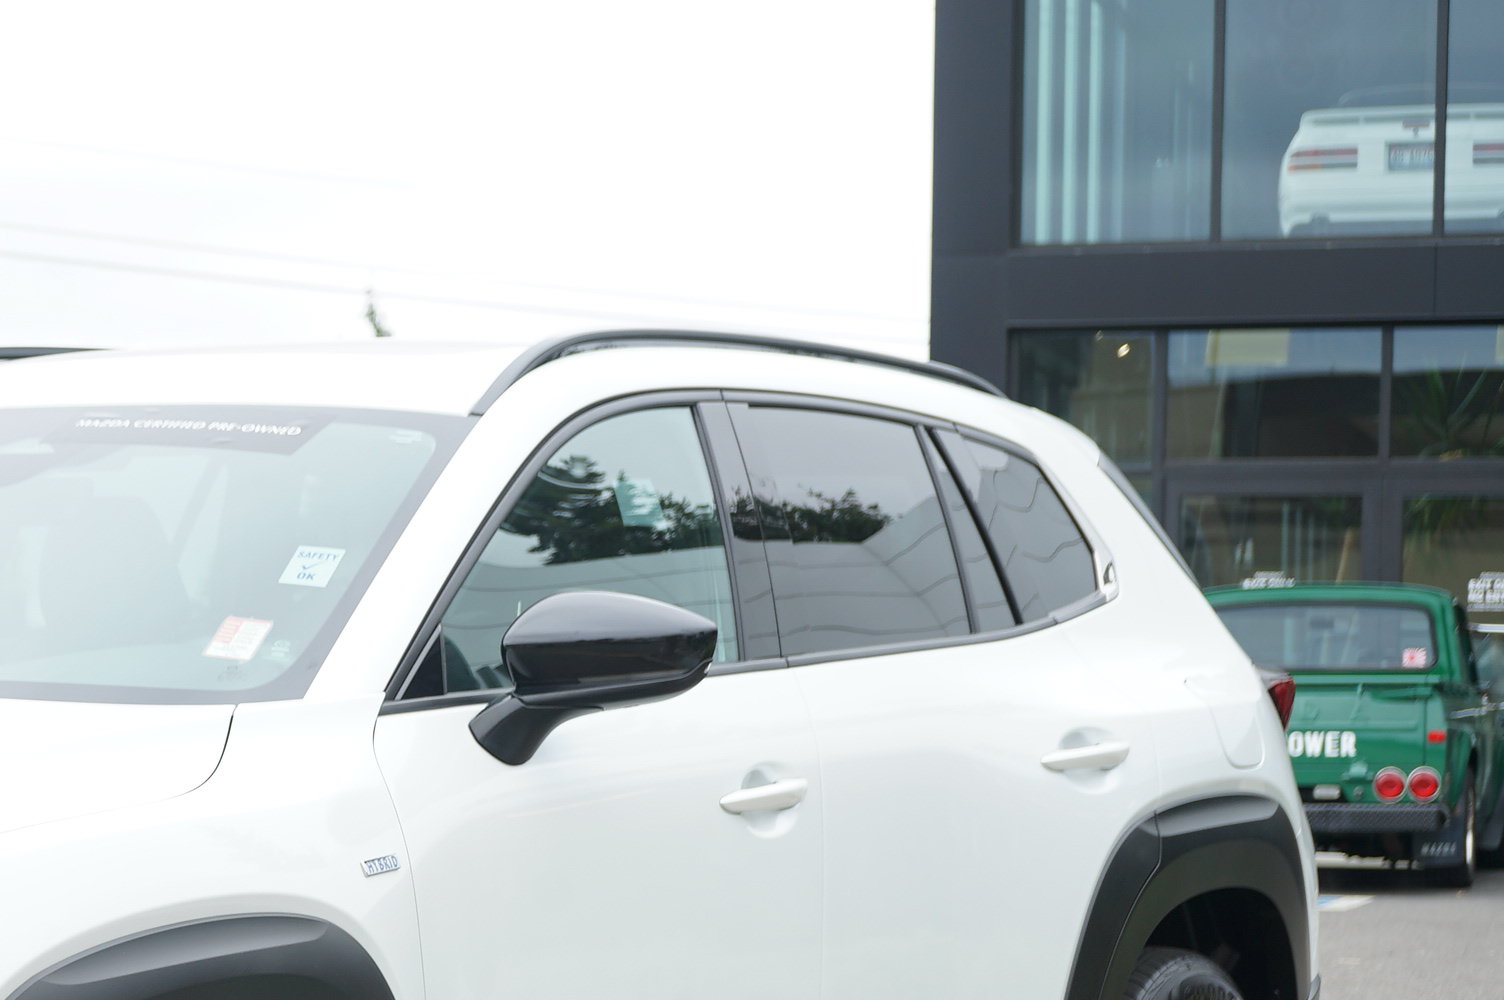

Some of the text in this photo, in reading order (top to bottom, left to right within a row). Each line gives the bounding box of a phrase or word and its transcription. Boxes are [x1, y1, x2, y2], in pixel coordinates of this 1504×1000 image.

[76, 419, 301, 436] MAZDA CERTIFIED PRE-OWNED
[297, 551, 339, 561] SAFETY
[297, 572, 316, 580] OK
[1288, 731, 1357, 757] OWER
[367, 855, 398, 874] HYBRID
